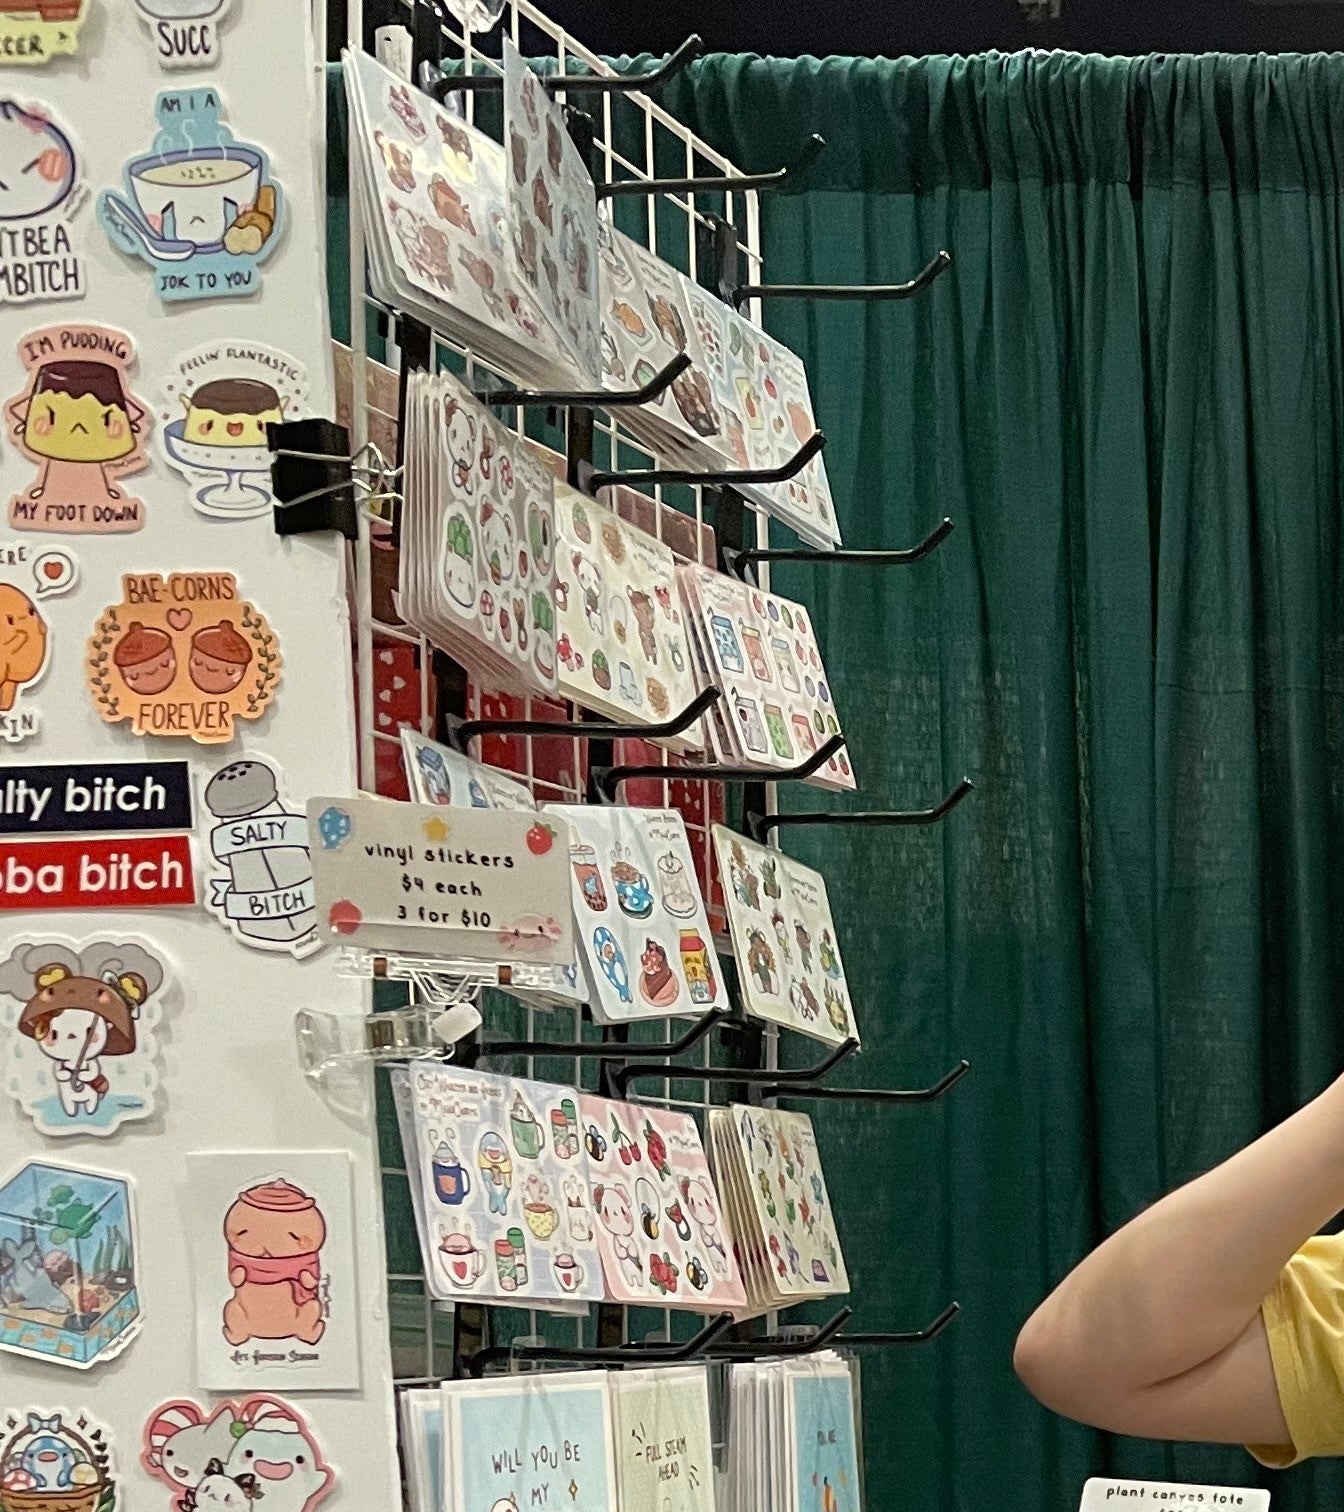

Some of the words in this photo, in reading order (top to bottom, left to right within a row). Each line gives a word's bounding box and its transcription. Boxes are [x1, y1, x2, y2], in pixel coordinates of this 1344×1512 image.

[158, 21, 212, 56] SUCC
[160, 96, 181, 113] AM
[54, 223, 71, 253] A
[195, 272, 218, 289] TO
[225, 269, 253, 288] YOU
[24, 335, 53, 362] I'M
[60, 331, 127, 360] PUDDING
[12, 502, 37, 519] MY
[45, 504, 87, 522] FOOT
[93, 503, 138, 523] DOWN
[127, 576, 237, 604] BAE-CORNS
[139, 701, 230, 730] FOREVER
[65, 776, 166, 813] bitch
[231, 820, 288, 845] SALTY
[365, 843, 414, 868] vinyl
[424, 849, 515, 869] stickers
[79, 849, 183, 892] bitch
[402, 873, 424, 893] $4
[435, 880, 483, 898] each
[249, 889, 305, 917] BITCH
[398, 905, 408, 920] 3
[418, 905, 450, 923] for
[461, 908, 491, 928] $10
[491, 1446, 523, 1475] WILL
[531, 1444, 559, 1472] YOU
[564, 1439, 582, 1462] BE
[531, 1482, 549, 1506] MY
[1107, 1487, 1145, 1499] plant
[1152, 1491, 1205, 1502] canvas
[1213, 1492, 1244, 1505] tote
